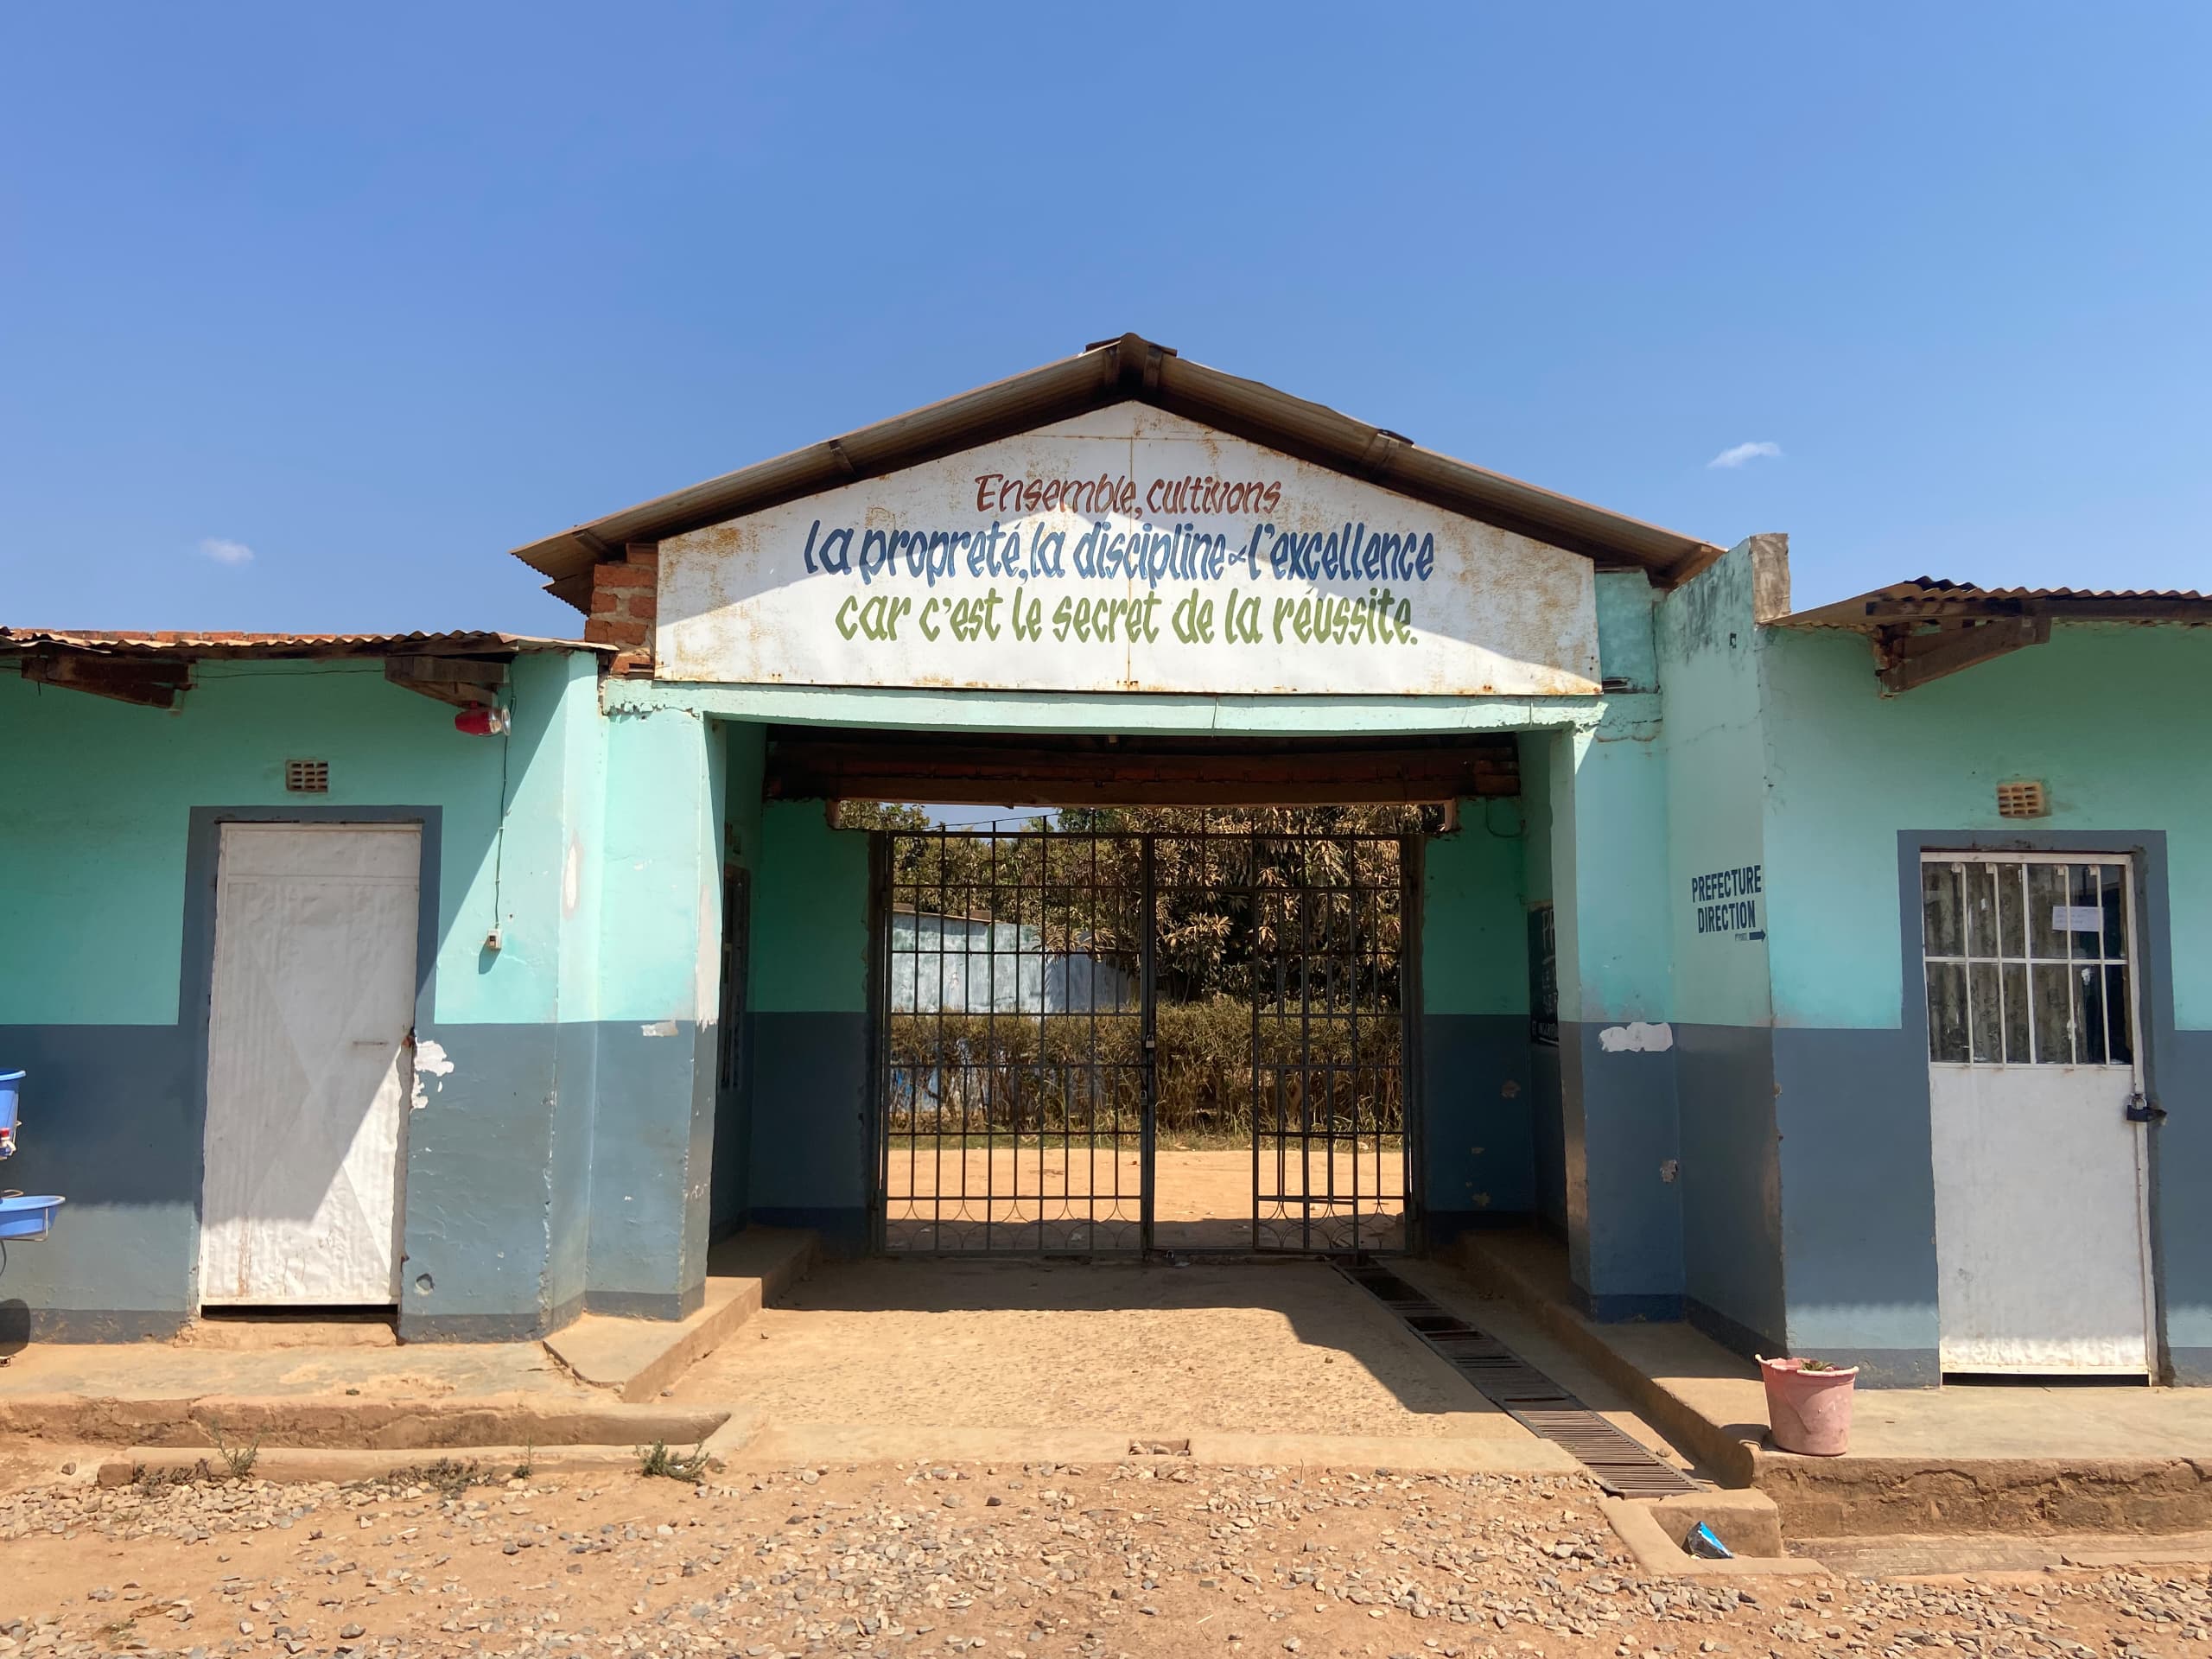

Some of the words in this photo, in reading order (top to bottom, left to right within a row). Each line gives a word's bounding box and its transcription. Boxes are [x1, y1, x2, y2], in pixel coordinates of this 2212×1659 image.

[975, 473, 1143, 519] Ensemble,
[1146, 475, 1281, 515] cultivons
[804, 519, 855, 575] la
[1072, 520, 1226, 589] discipline
[835, 594, 912, 641] car
[918, 587, 1003, 642] c'est
[1011, 586, 1042, 642] le
[1052, 590, 1162, 644] secret
[1172, 588, 1215, 645] de
[1224, 588, 1263, 645] la
[1272, 586, 1418, 645] réussite.
[1691, 864, 1762, 904] PREFECTURE
[1697, 899, 1756, 934] DIRECTION
